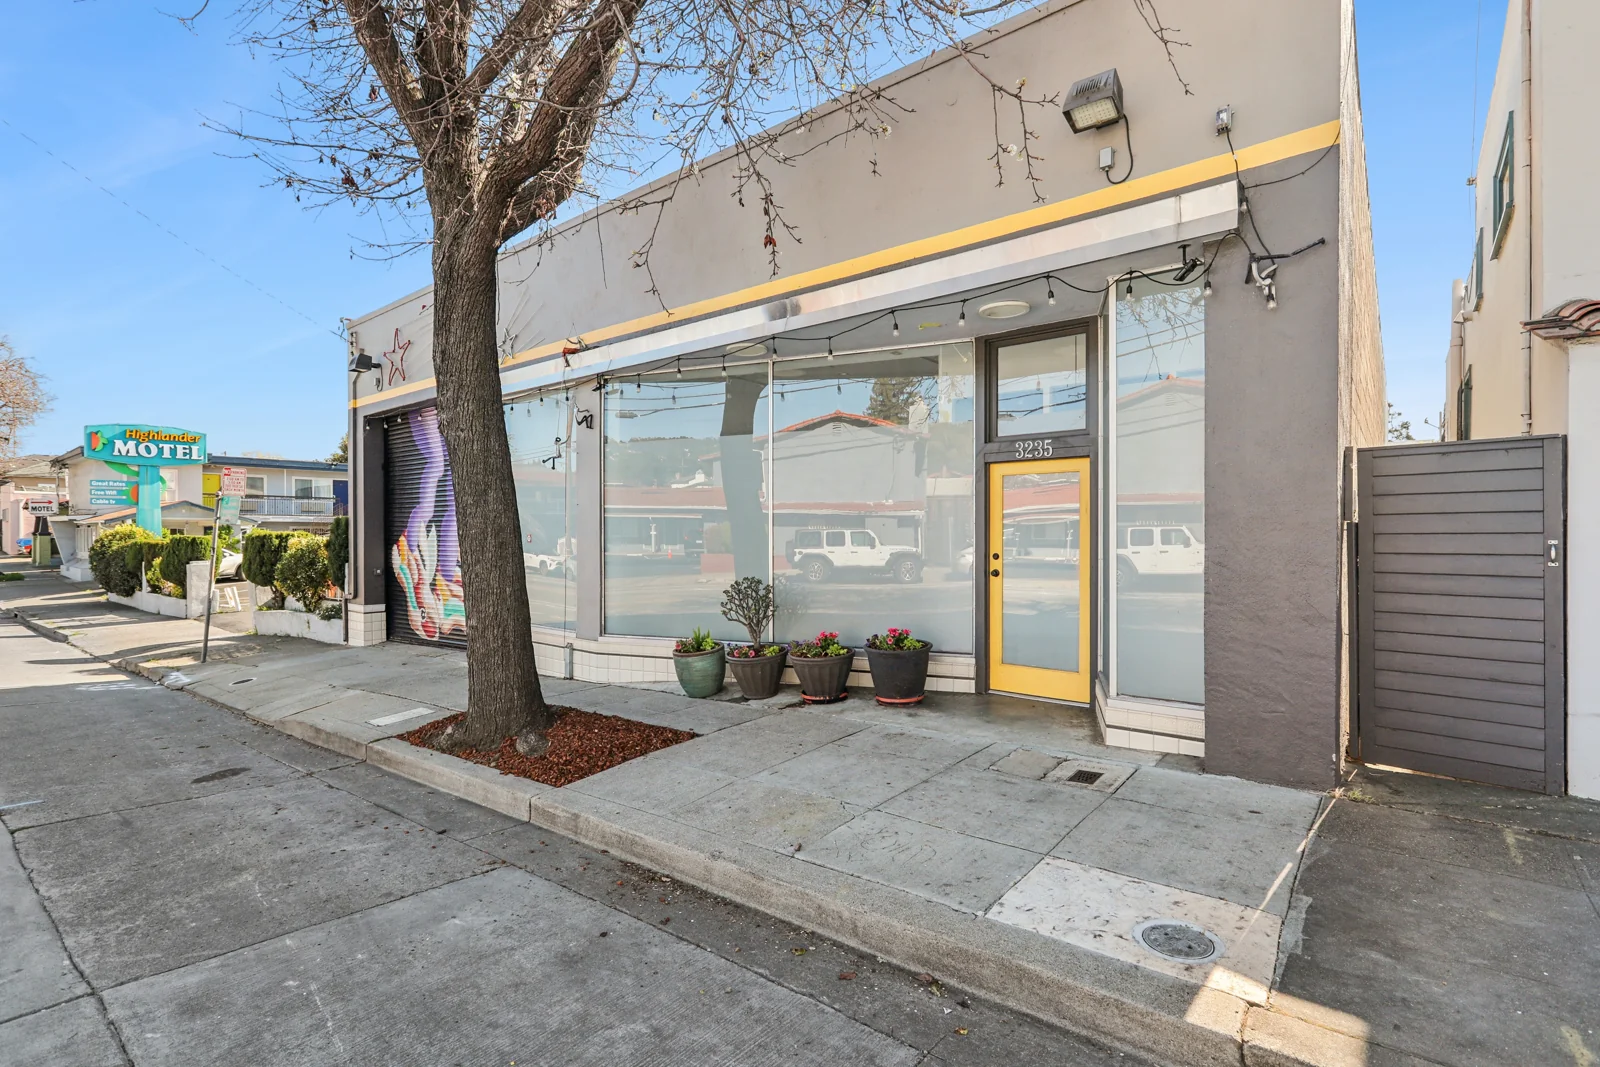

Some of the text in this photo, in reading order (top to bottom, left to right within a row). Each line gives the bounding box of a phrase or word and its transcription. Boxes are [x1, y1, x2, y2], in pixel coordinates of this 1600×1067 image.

[125, 428, 202, 443] Highlander
[113, 439, 204, 460] MOTEL
[1015, 439, 1053, 459] 3235
